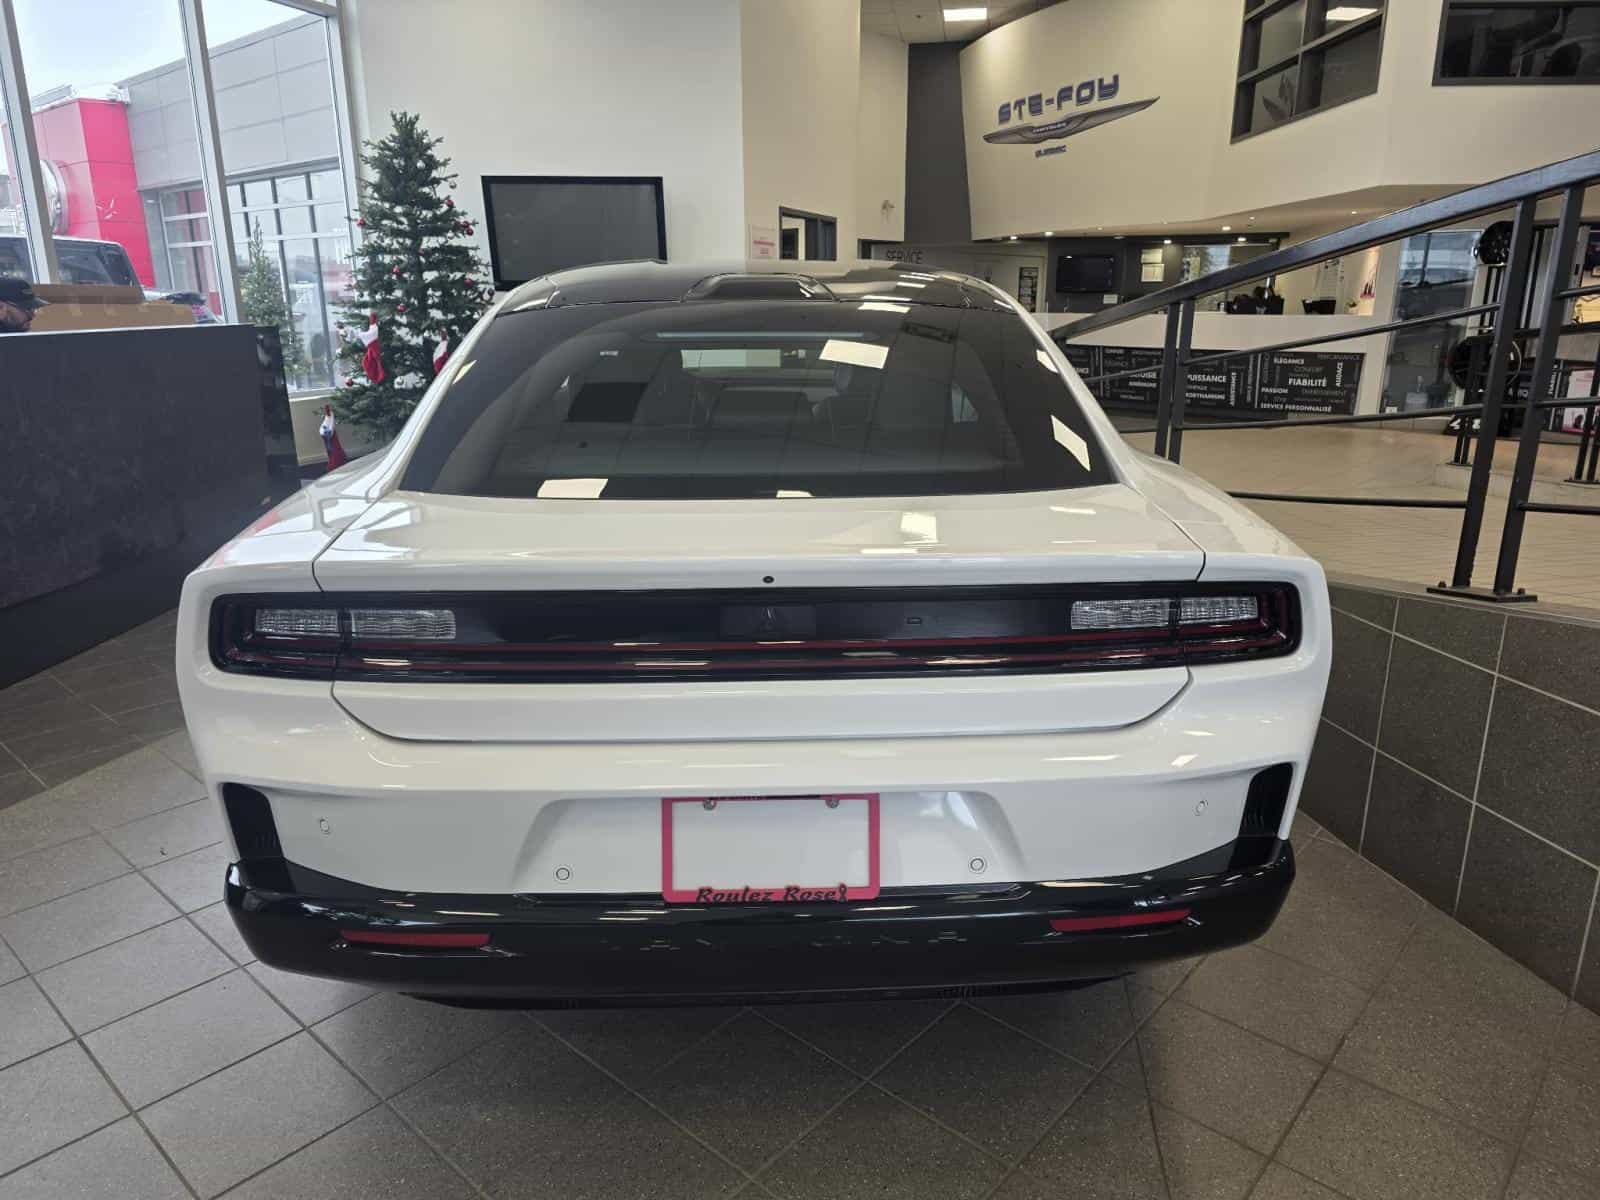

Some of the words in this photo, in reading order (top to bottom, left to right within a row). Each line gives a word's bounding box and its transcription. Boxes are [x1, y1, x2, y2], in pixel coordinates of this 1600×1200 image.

[998, 74, 1119, 125] STE-FOY
[1288, 376, 1328, 387] FIABILITÉ
[696, 885, 774, 903] Roulez
